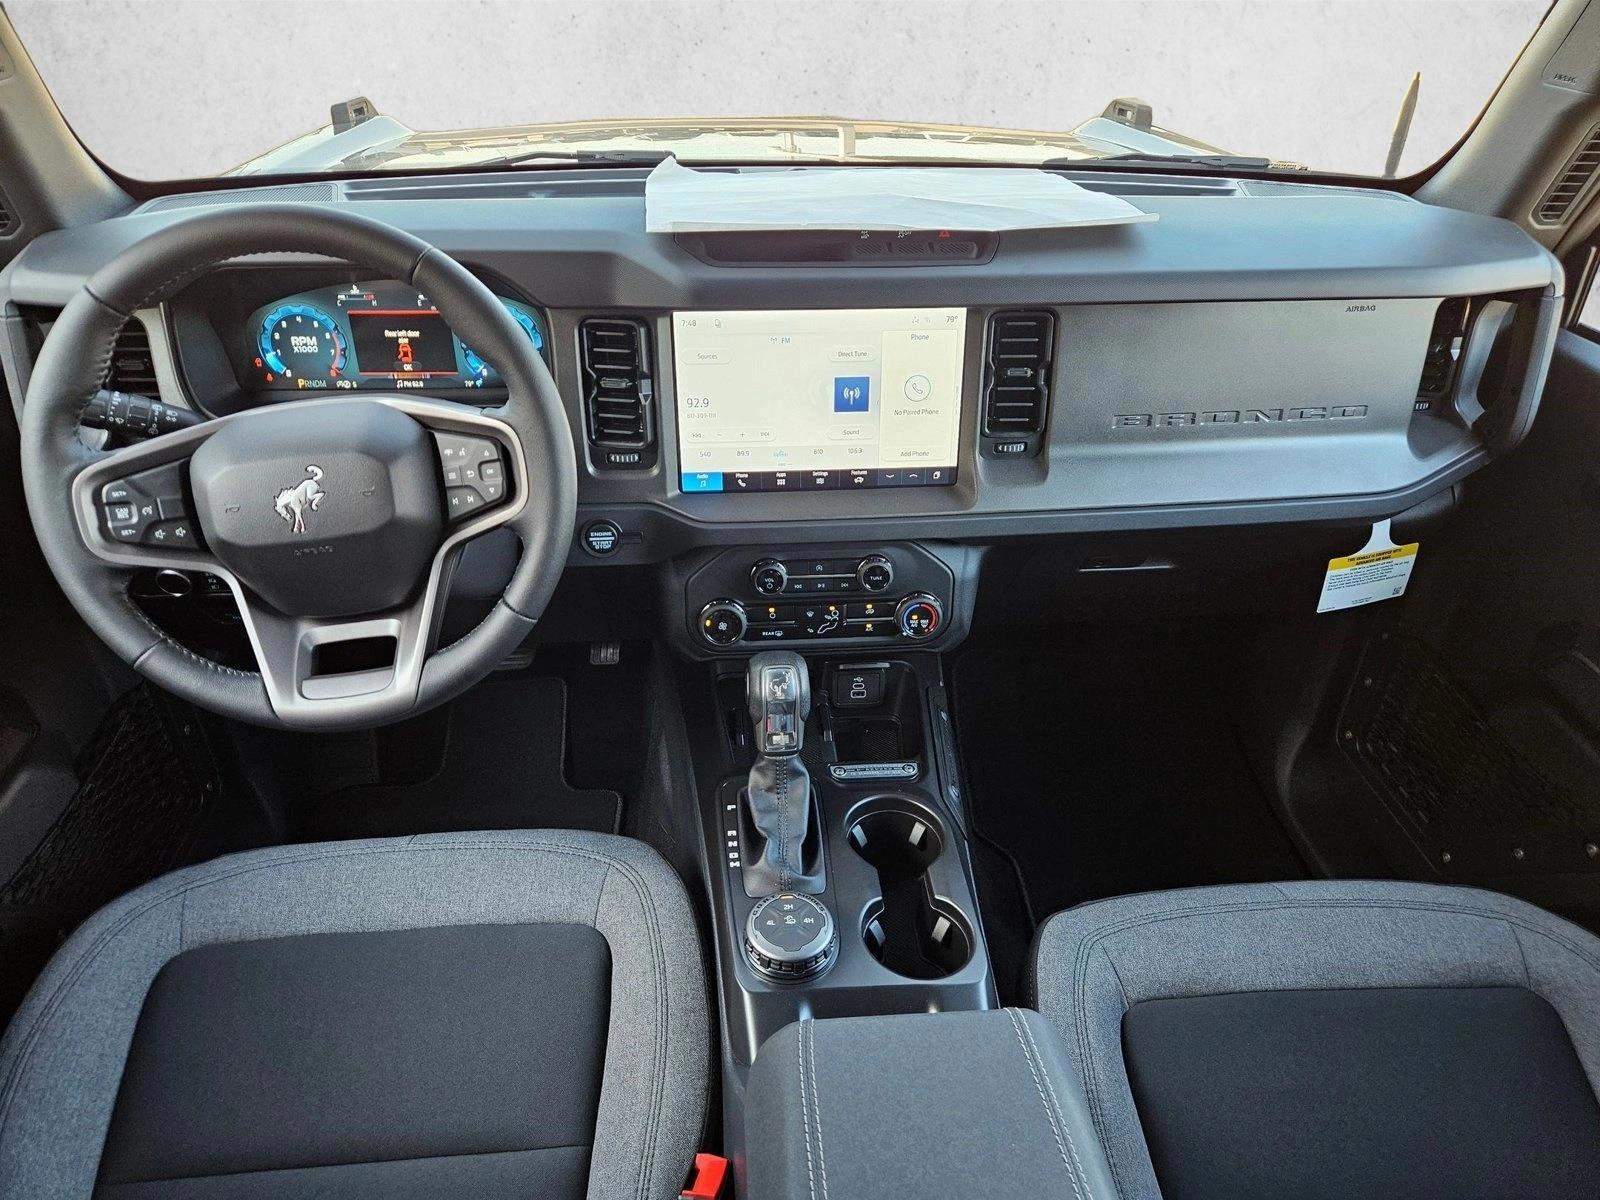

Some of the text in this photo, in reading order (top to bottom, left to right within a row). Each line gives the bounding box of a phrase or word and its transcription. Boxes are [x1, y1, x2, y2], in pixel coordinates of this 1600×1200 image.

[1345, 304, 1377, 313] AIRBAG
[681, 319, 697, 327] 7:48
[290, 336, 318, 346] RPM
[910, 333, 930, 341] Phone
[686, 397, 710, 408] 92.9
[903, 408, 920, 416] Paired
[1111, 404, 1369, 429] BRONCO
[783, 903, 794, 911] 2H
